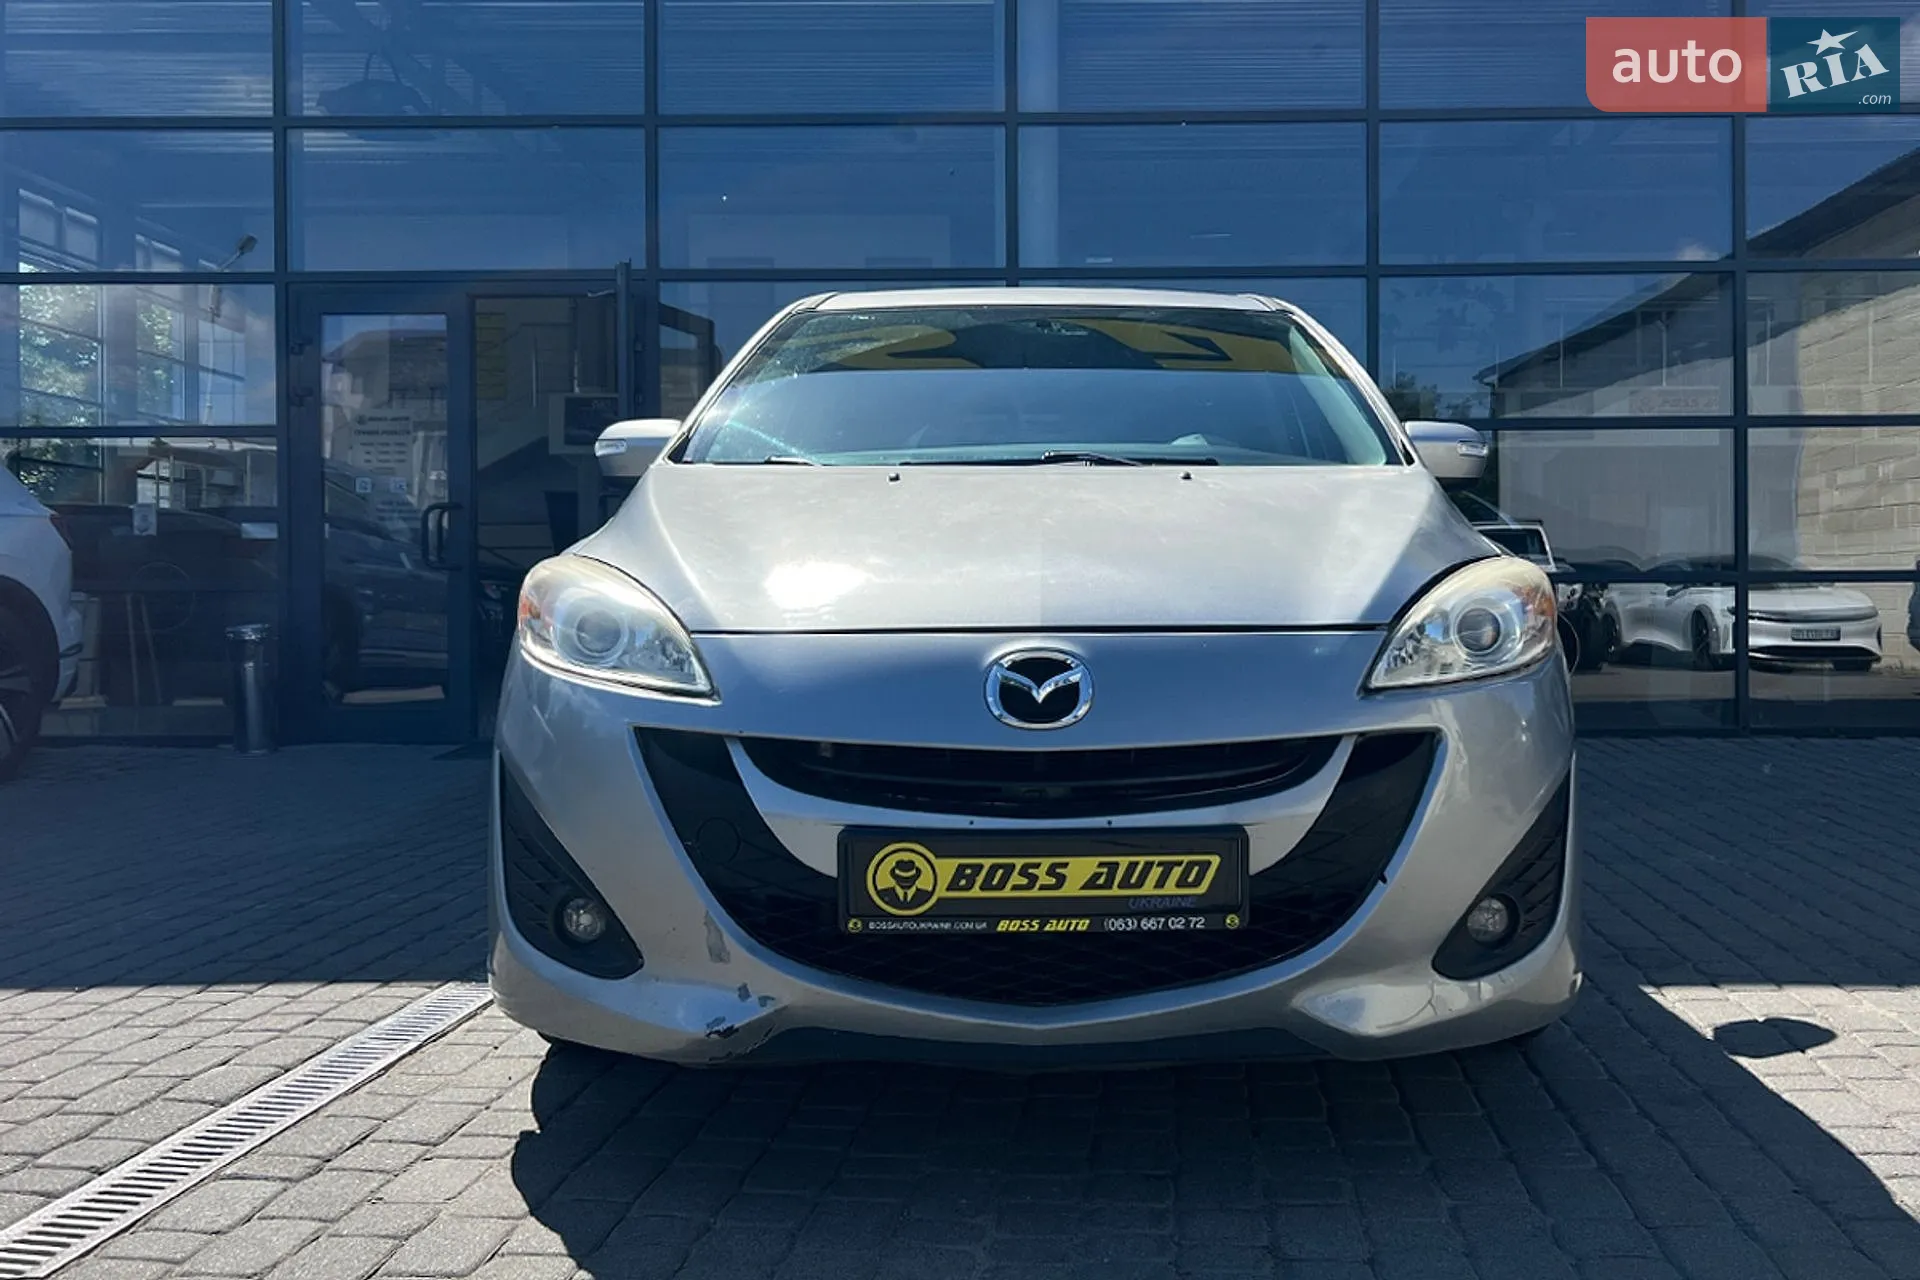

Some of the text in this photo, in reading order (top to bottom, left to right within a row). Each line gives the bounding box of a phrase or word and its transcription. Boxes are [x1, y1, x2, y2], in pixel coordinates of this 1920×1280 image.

[945, 860, 1212, 892] BOSS AUTO
[1128, 897, 1197, 909] UKRAINE
[996, 919, 1090, 932] BOSS AUTO
[1104, 917, 1206, 931] (063) 667 02 72
